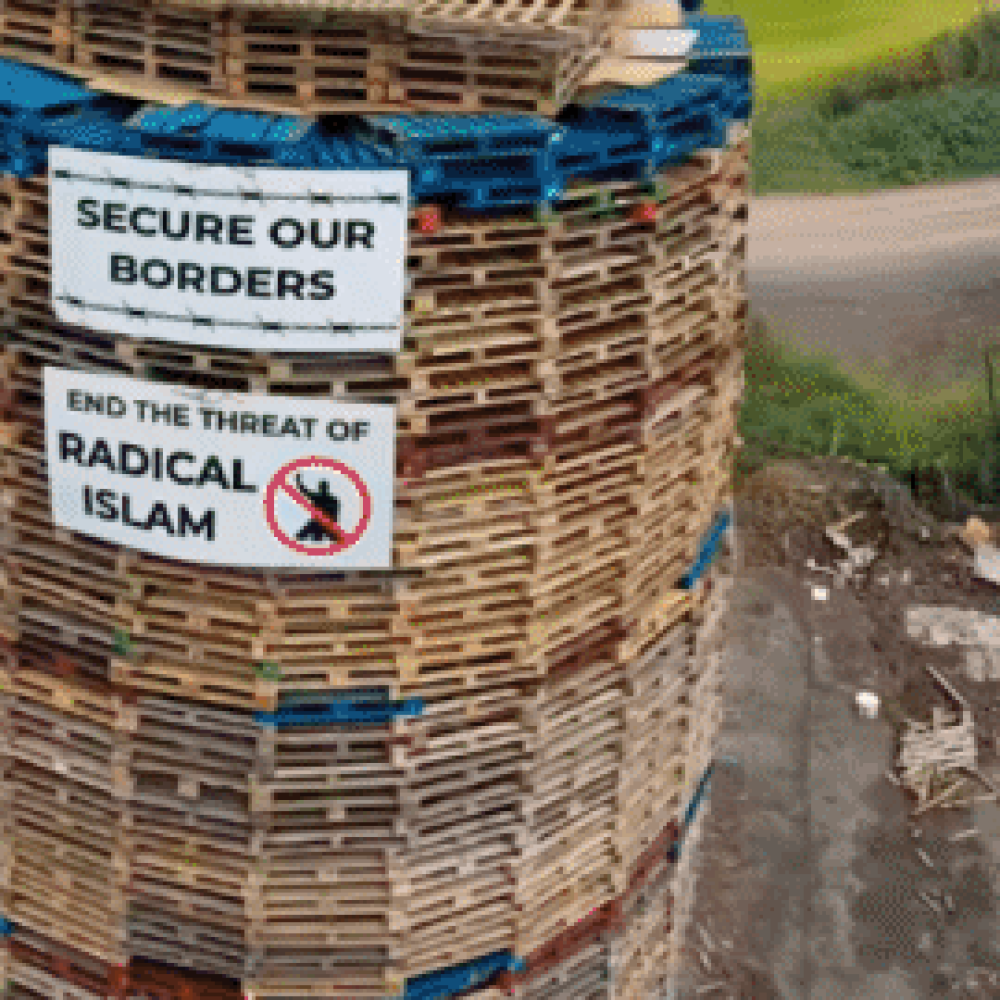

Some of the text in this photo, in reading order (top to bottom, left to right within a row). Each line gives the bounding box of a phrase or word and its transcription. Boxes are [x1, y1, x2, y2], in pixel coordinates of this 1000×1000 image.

[76, 197, 376, 251] SECURE OUR
[108, 252, 336, 301] BORDERS
[66, 388, 371, 443] END THE THREAT OF
[58, 430, 259, 493] RADICAL
[81, 485, 217, 542] ISLAM
